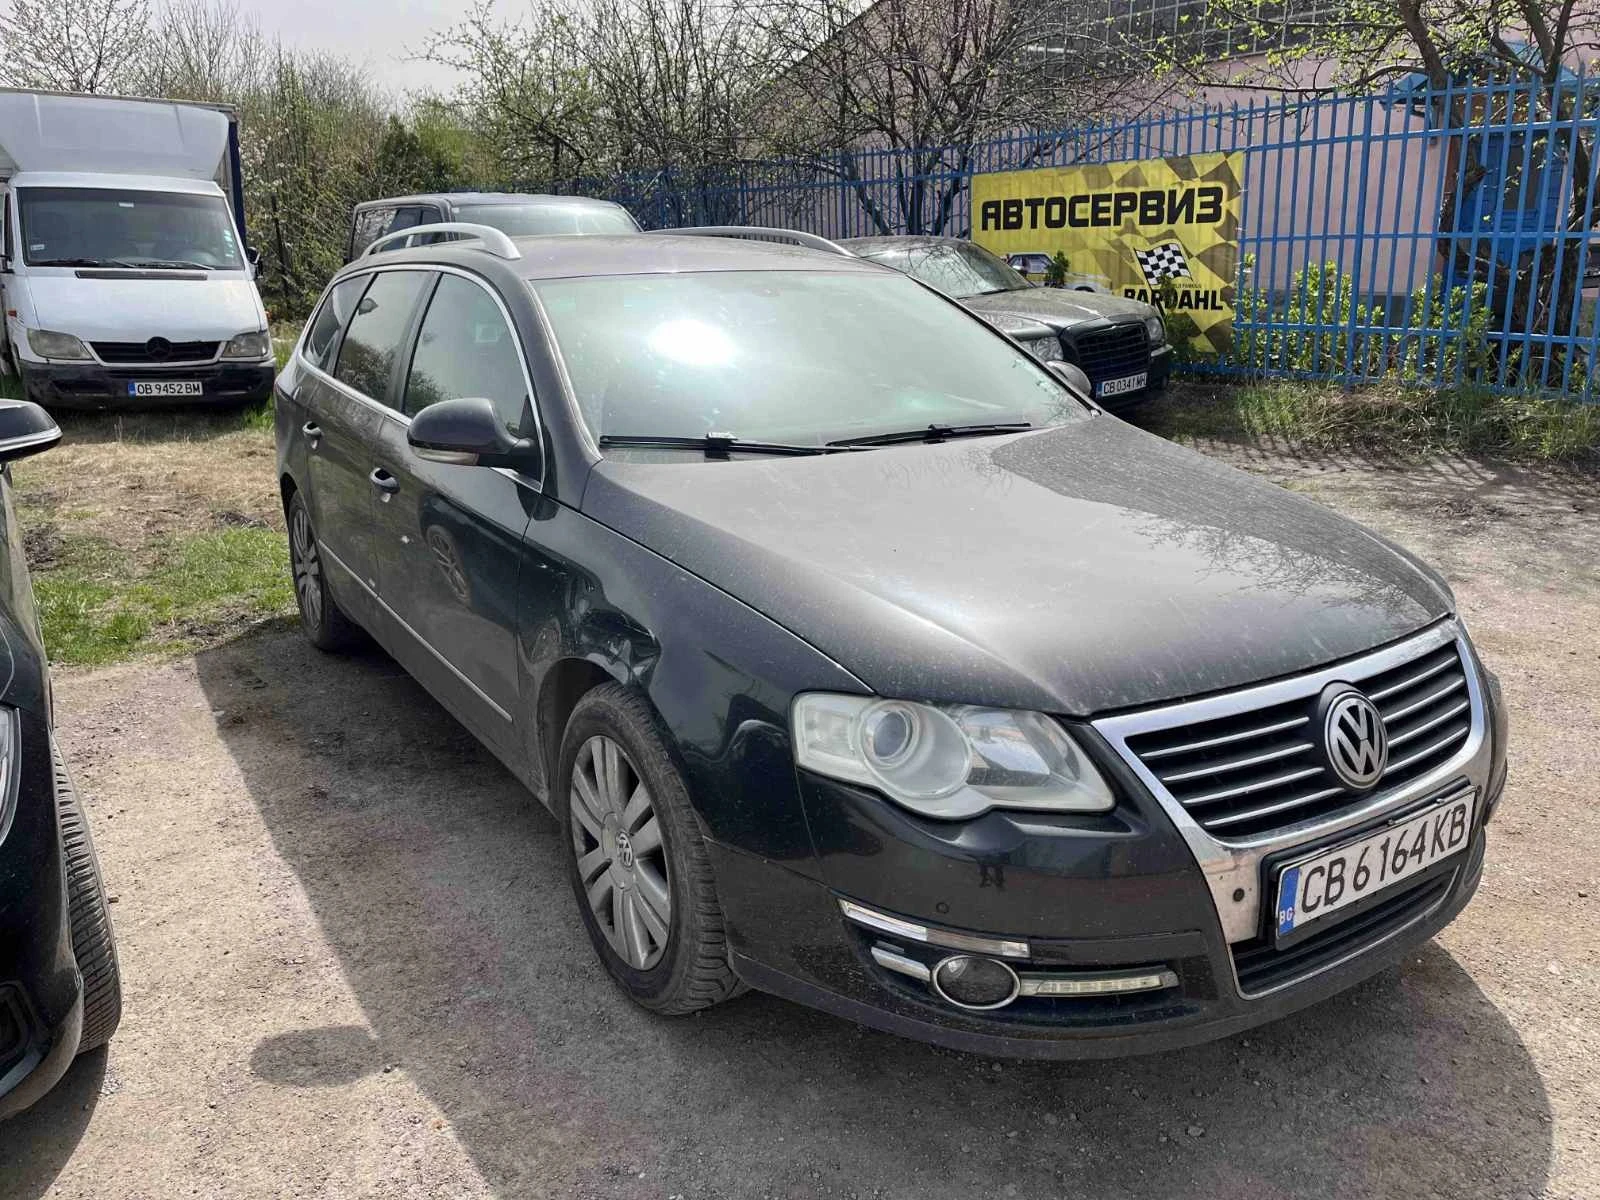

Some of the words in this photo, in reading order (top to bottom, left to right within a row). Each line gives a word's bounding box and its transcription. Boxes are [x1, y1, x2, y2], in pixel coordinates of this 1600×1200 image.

[981, 186, 1224, 231] АВТОСЕРВИЗ
[155, 383, 184, 394] 9452
[1301, 856, 1346, 913] CB
[1352, 820, 1429, 892] 6164
[1430, 803, 1467, 858] KB
